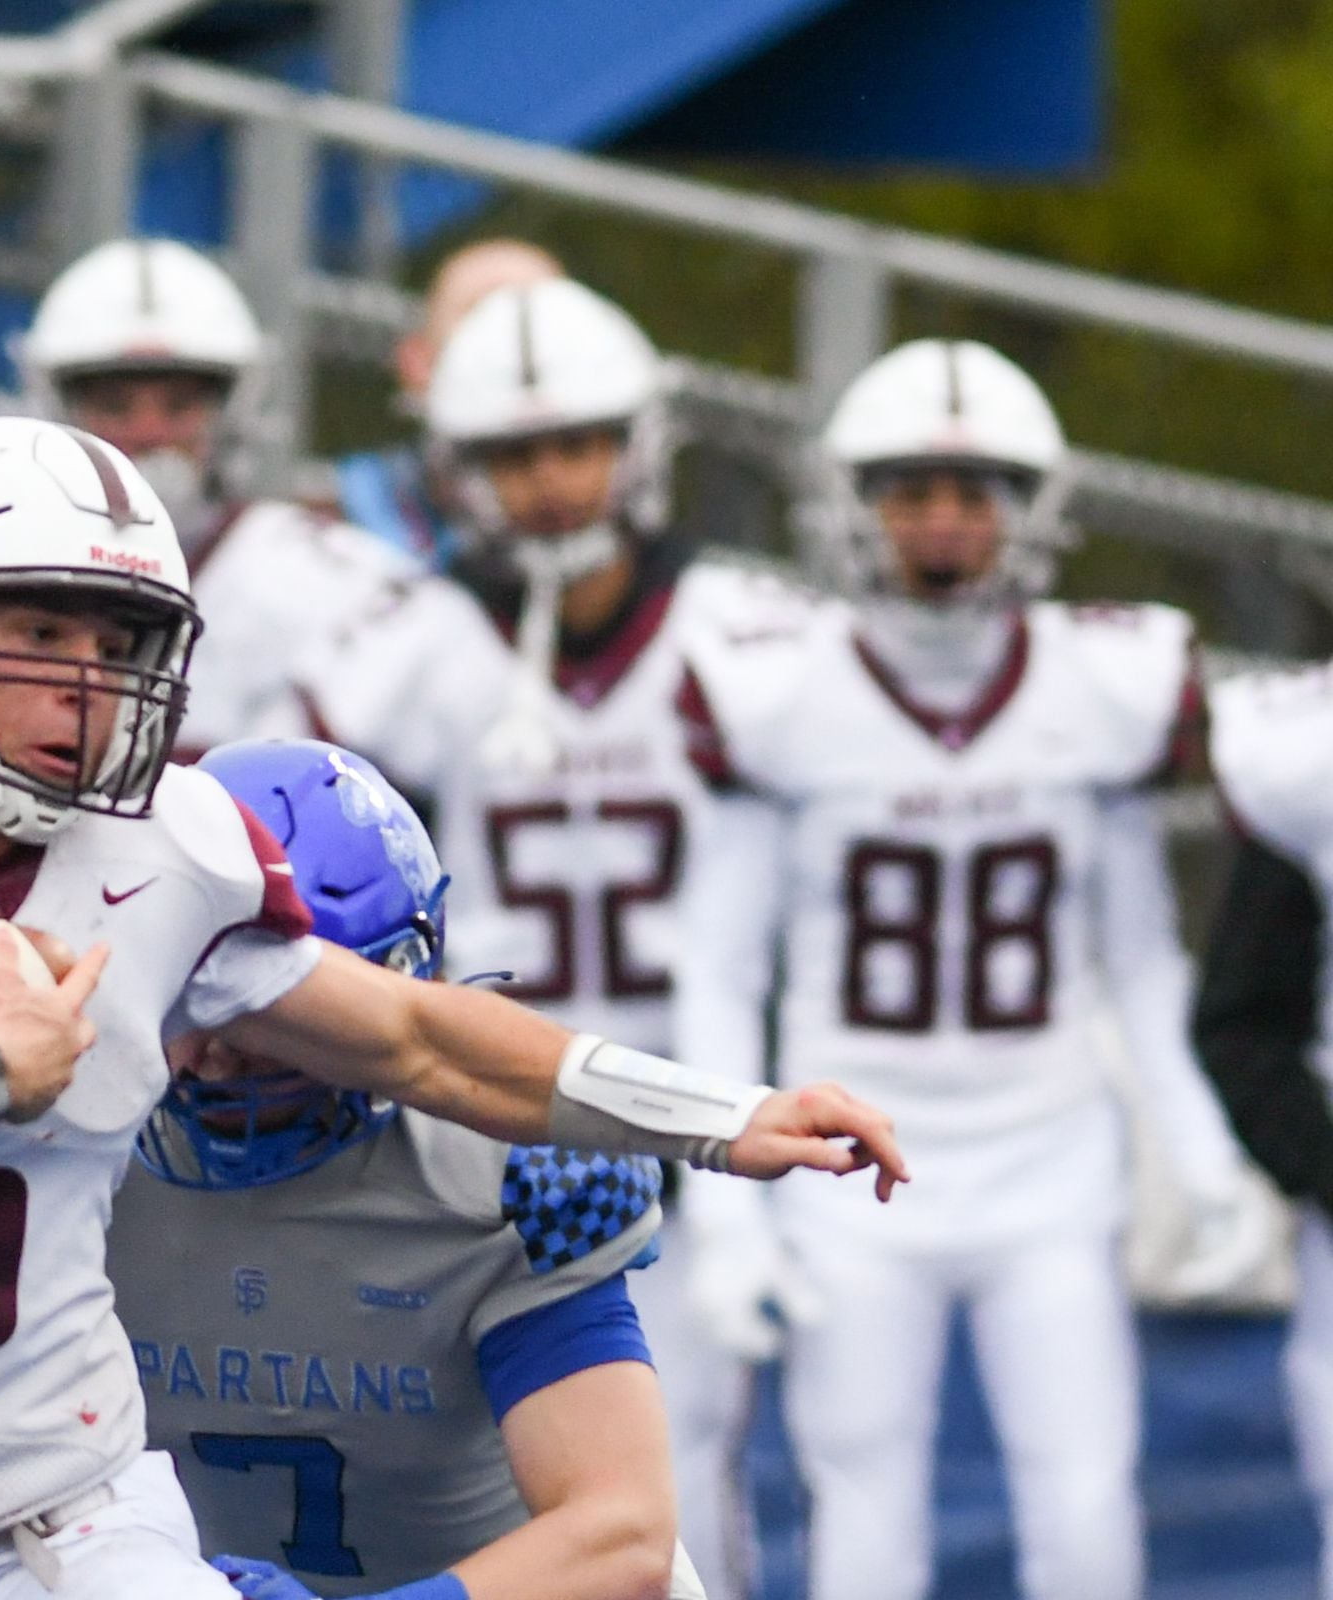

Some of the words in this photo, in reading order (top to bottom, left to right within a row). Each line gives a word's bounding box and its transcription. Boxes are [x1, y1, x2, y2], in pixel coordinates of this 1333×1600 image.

[485, 799, 685, 1001] 52
[844, 838, 1057, 1032] 88
[132, 1339, 435, 1415] PARTANS
[190, 1432, 365, 1577] 7
